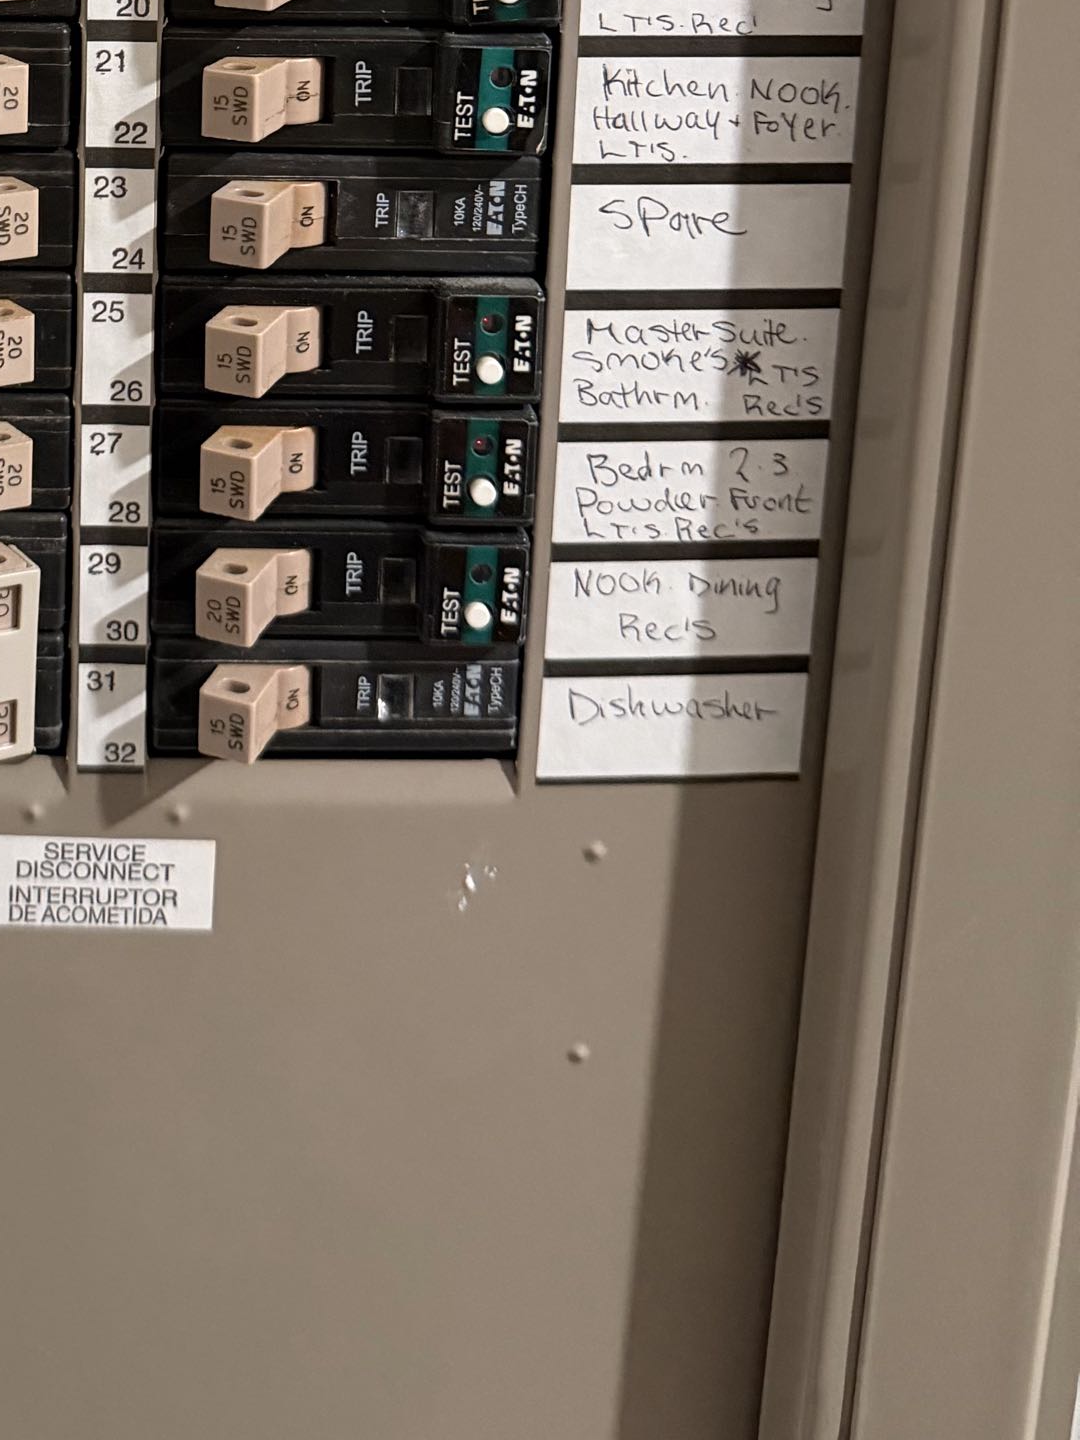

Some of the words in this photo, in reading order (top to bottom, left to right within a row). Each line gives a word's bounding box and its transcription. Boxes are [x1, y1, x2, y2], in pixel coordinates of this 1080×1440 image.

[95, 49, 126, 73] 21
[3, 85, 19, 111] 20
[114, 121, 148, 145] 22
[93, 175, 128, 200] 23
[374, 192, 391, 229] TRIP
[221, 223, 237, 242] 15
[240, 215, 257, 256] SWD
[112, 247, 146, 270] 24
[91, 300, 125, 323] 25
[586, 317, 710, 346] Master
[7, 335, 23, 360] 20
[109, 380, 144, 402] 26
[90, 432, 123, 456] 27
[586, 450, 704, 487] Bedrm
[729, 483, 813, 514] Front
[108, 500, 141, 524] 28
[88, 552, 121, 575] 29
[688, 572, 781, 614] Dining
[206, 598, 223, 624] 20
[225, 595, 242, 635] SWD
[440, 587, 462, 638] TEST
[106, 620, 139, 642] 30
[87, 670, 116, 692] 31
[569, 683, 777, 726] Dishwasher
[104, 742, 137, 763] 32
[44, 842, 146, 863] SERVICE
[16, 860, 175, 882] DISCONNECT
[8, 885, 178, 907] INTERRUPTOR
[8, 904, 37, 923] DE
[40, 905, 168, 925] ACOMETIDA
